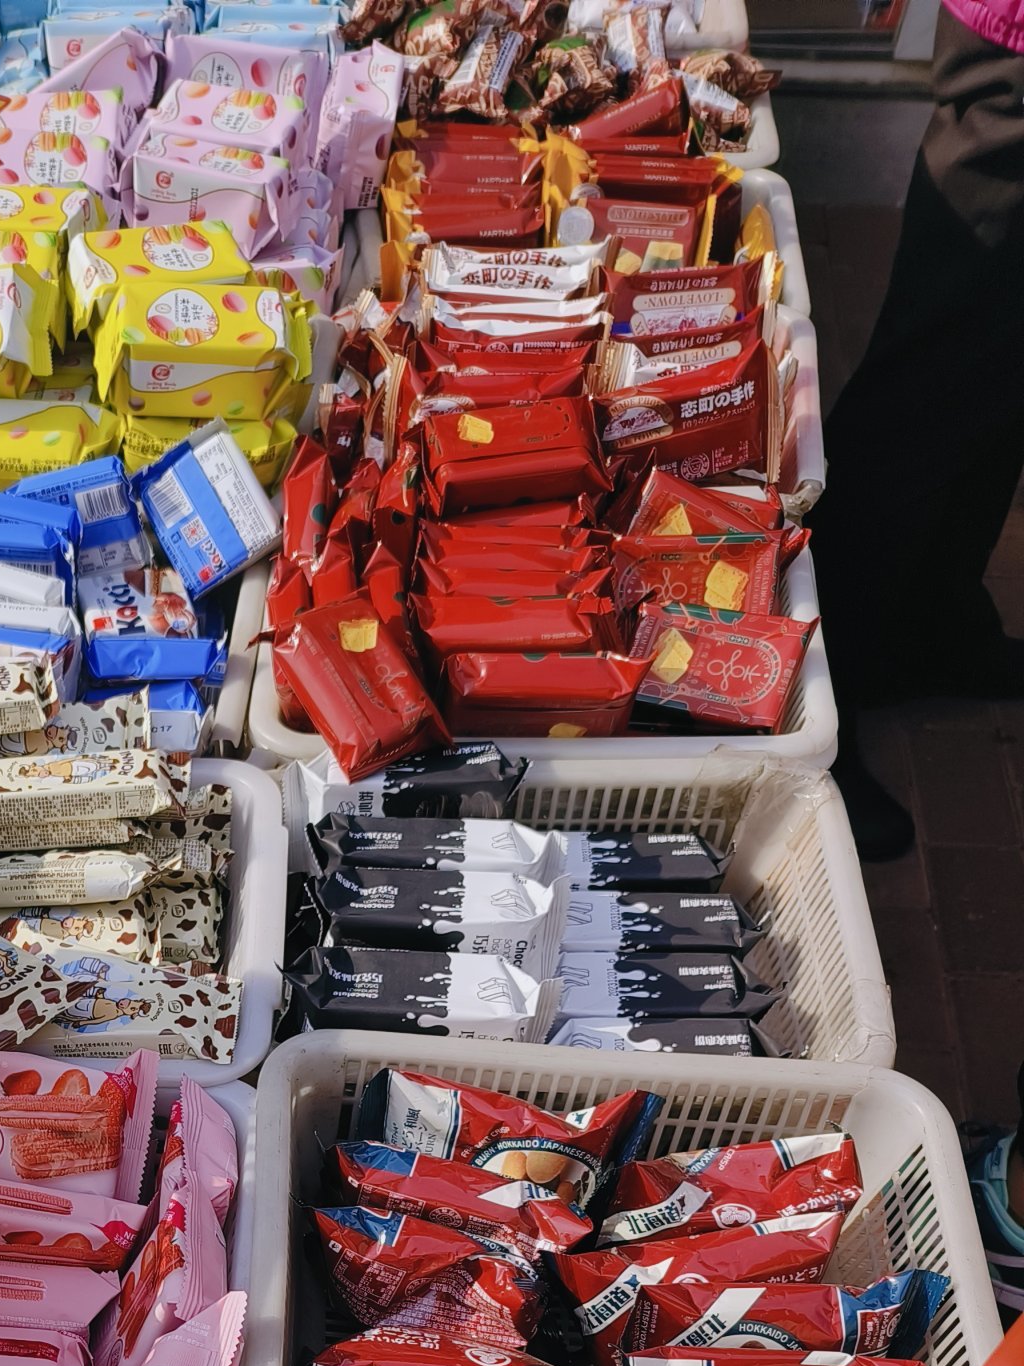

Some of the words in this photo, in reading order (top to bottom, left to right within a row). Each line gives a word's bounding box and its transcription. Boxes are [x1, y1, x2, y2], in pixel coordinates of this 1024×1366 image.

[497, 1138, 539, 1152] HOKKAIDO
[539, 1139, 585, 1160] JAPANESE
[625, 1202, 684, 1236] 北海道
[738, 1323, 777, 1344] HOKKAIDO
